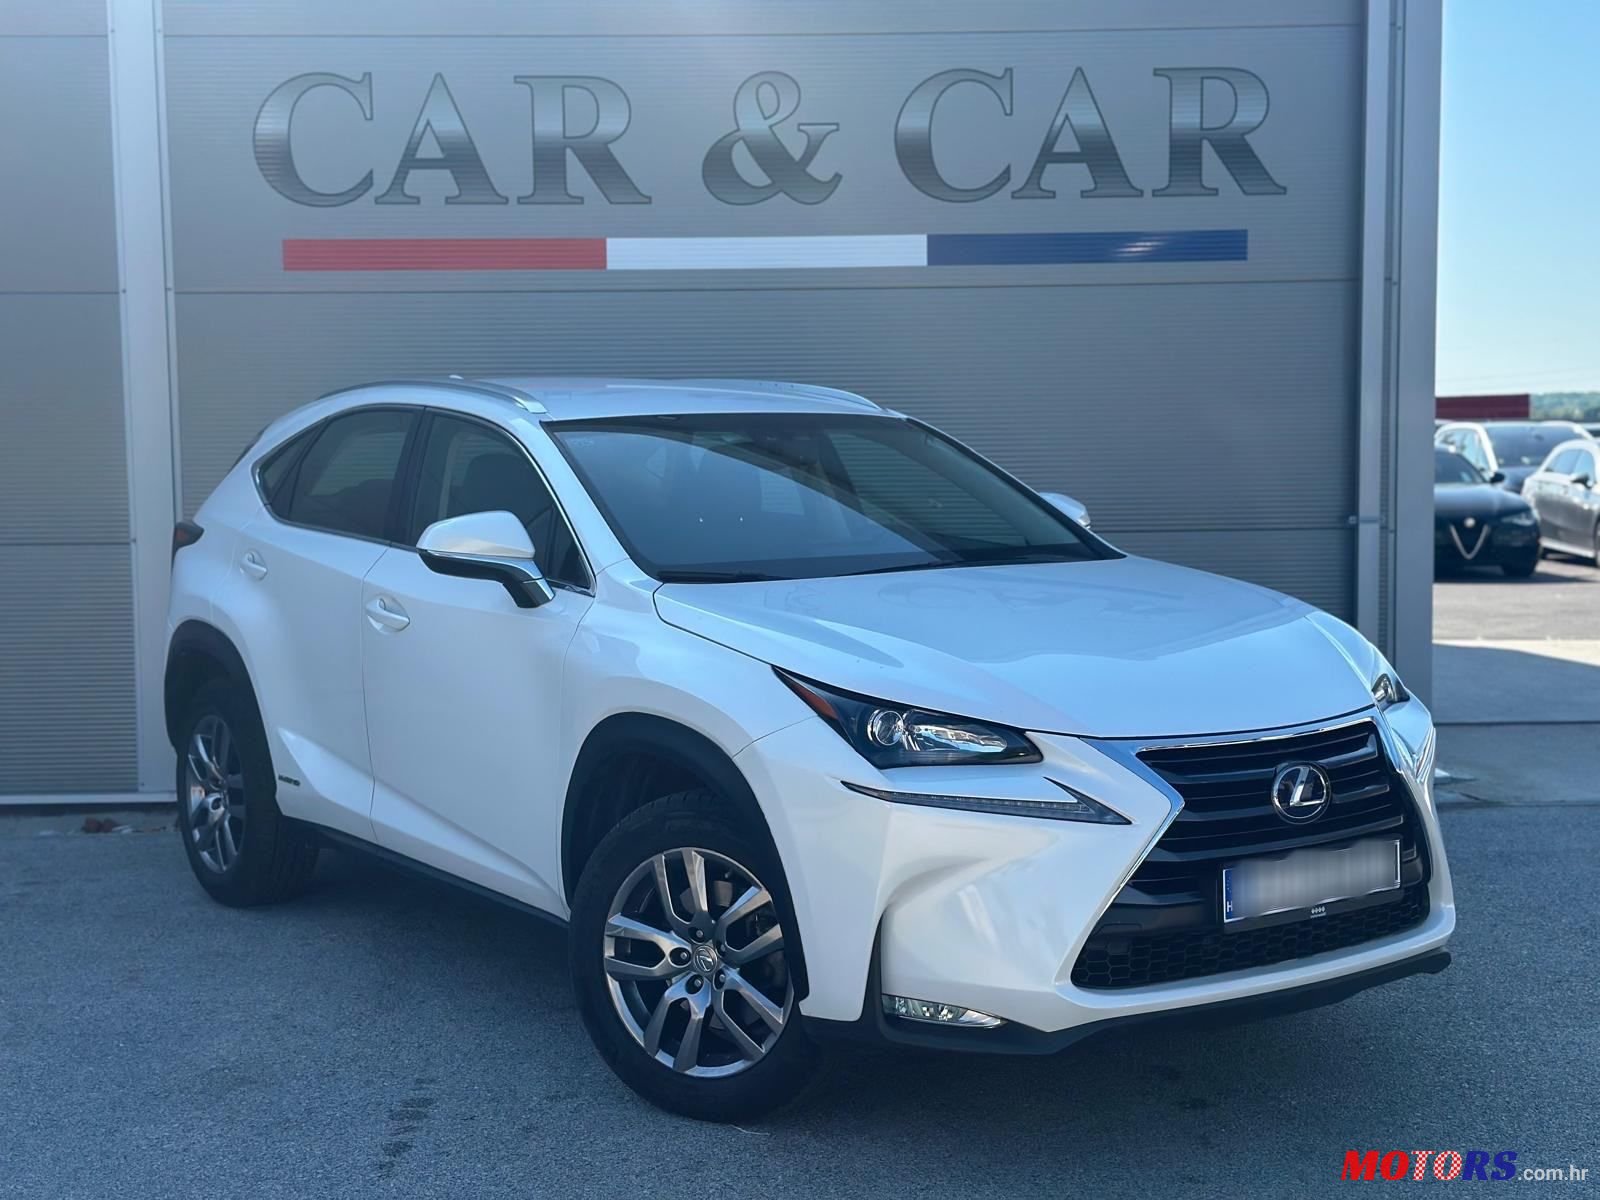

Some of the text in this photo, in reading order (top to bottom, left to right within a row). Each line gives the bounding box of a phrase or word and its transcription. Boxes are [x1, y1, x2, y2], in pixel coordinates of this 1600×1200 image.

[253, 66, 1287, 207] CAR & CAR
